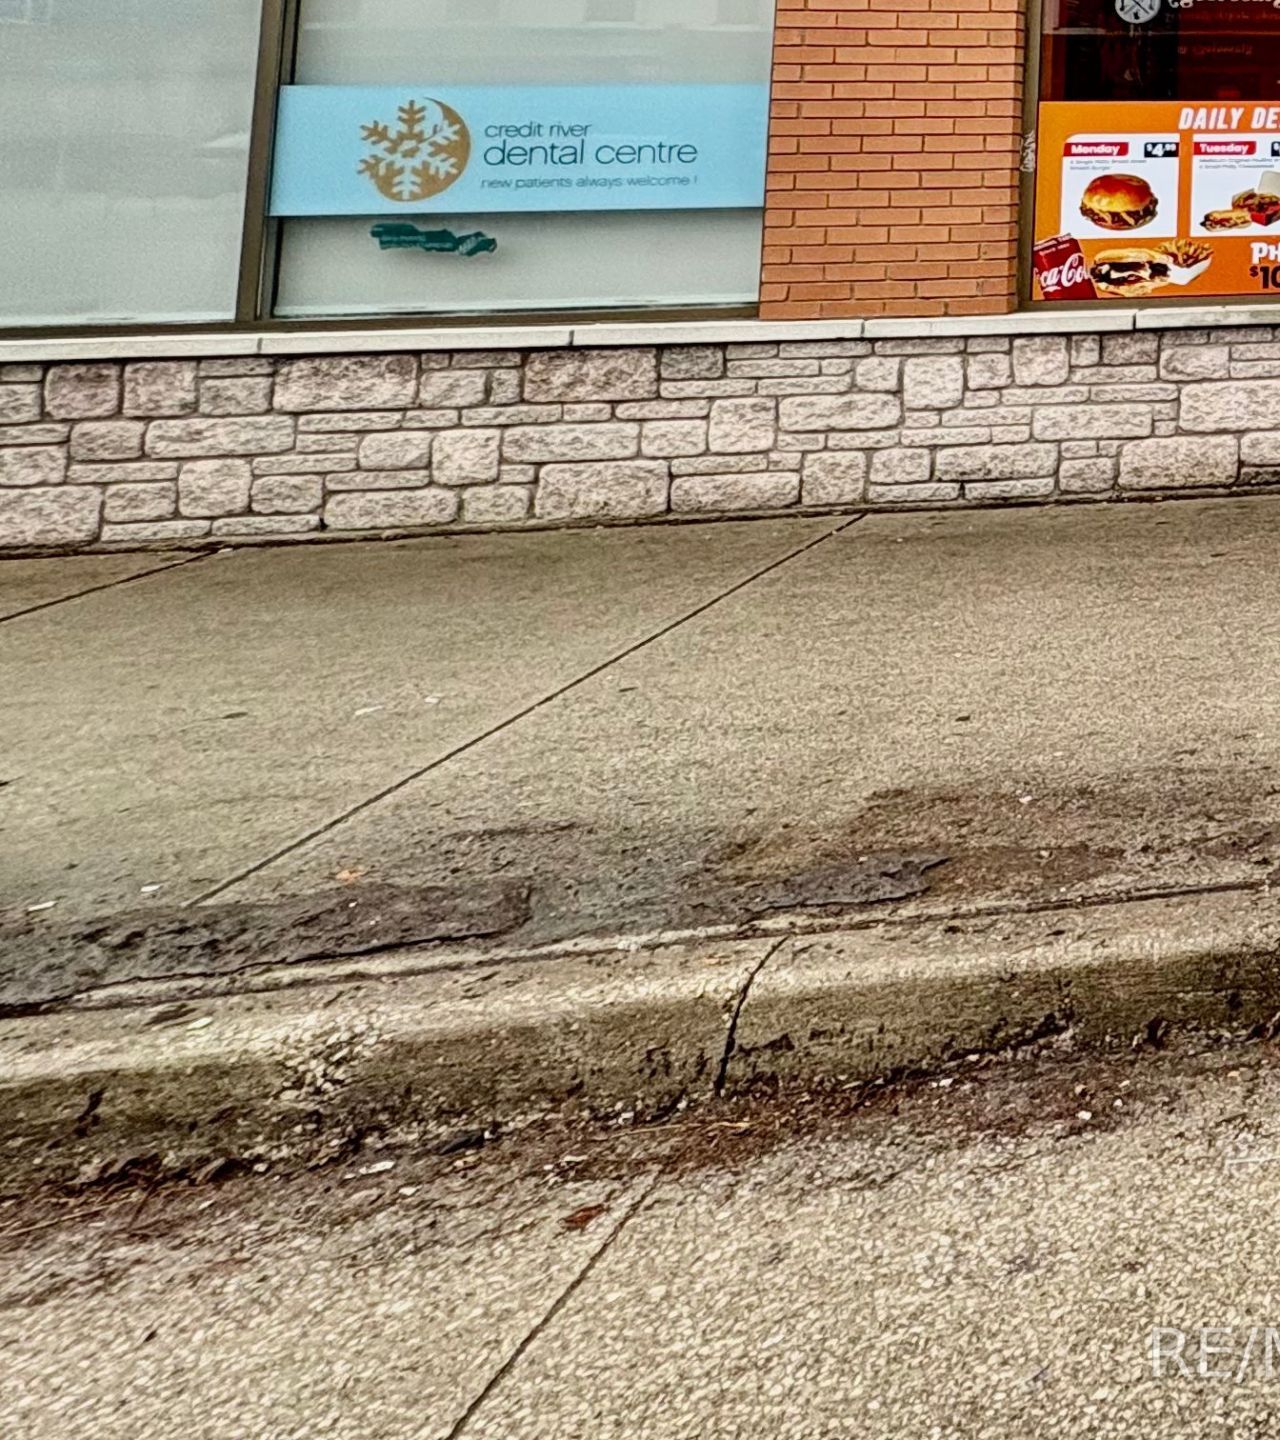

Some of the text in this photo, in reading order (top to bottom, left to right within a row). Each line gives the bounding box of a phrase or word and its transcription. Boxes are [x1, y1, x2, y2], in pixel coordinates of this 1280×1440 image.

[1178, 106, 1245, 130] DAILY
[484, 121, 592, 138] credit river
[484, 139, 698, 165] dental centre
[1071, 144, 1120, 157] Monday
[1199, 143, 1249, 155] Tuesday
[481, 178, 511, 188] new
[515, 176, 572, 190] patients
[576, 176, 622, 189] always
[627, 175, 689, 187] welcome
